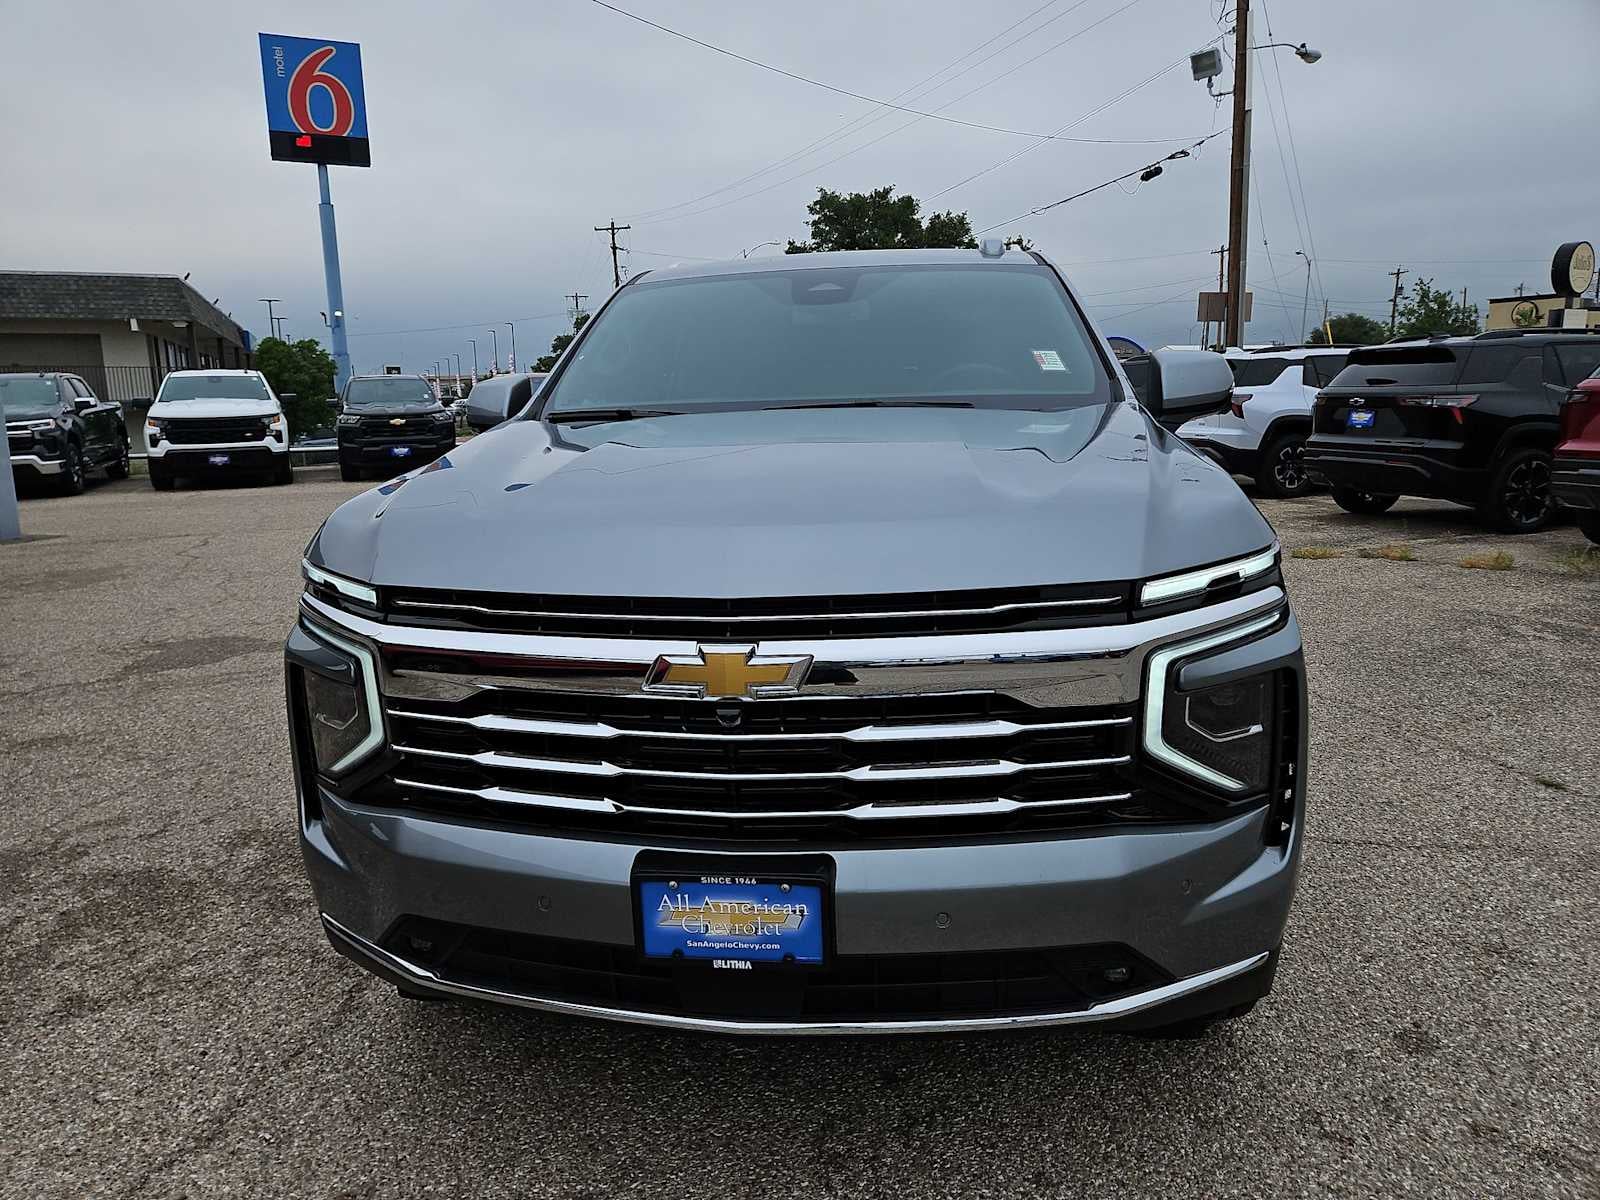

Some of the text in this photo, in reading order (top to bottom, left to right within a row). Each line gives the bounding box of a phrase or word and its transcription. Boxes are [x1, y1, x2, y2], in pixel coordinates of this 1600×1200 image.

[272, 46, 285, 77] motel
[287, 45, 355, 137] 6
[700, 876, 732, 885] SINCE
[657, 894, 809, 915] All American
[681, 915, 782, 936] Chevrolet
[686, 940, 780, 950] SanAngeloChevy.com
[721, 959, 753, 970] LITHIA
